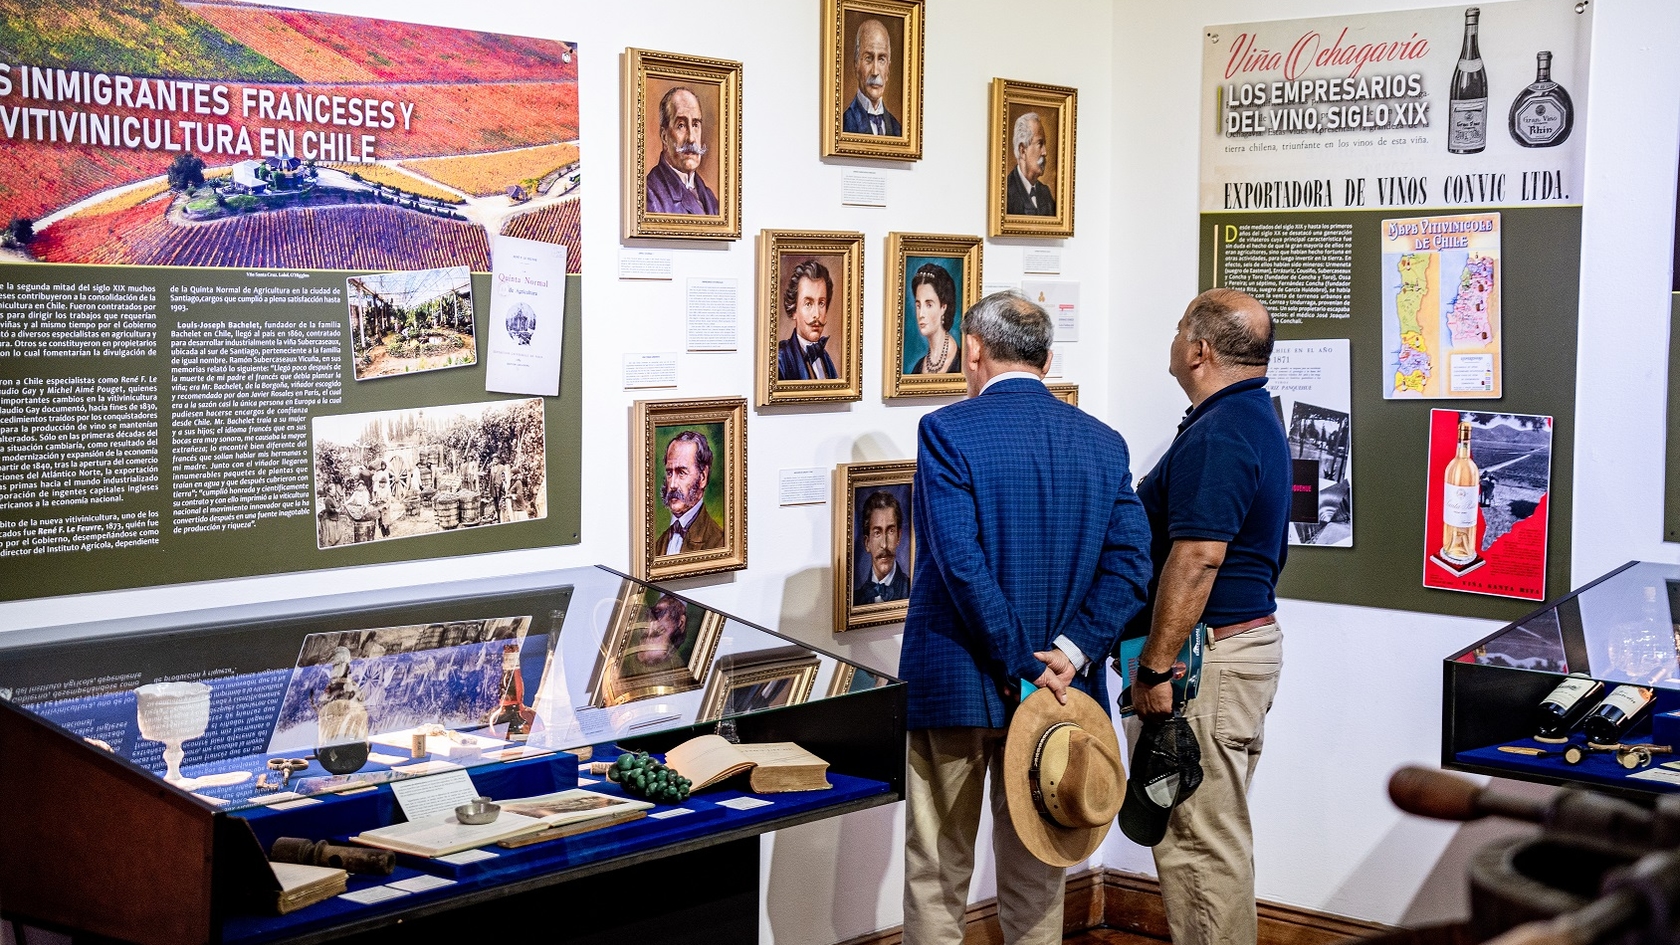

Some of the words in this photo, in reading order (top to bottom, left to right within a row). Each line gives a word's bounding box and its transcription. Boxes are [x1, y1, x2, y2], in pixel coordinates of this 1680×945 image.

[1225, 33, 1282, 80] Viña
[1284, 27, 1430, 82] Ochagavía
[21, 65, 230, 116] INMIGRANTES
[242, 88, 395, 129] FRANCESES
[400, 102, 414, 129] Y
[1229, 83, 1266, 106] LOS
[1271, 74, 1421, 103] EMPRESARIOS
[0, 105, 253, 155] VITIVINICULTURA
[260, 127, 294, 157] EN
[303, 131, 376, 163] CHILE
[1228, 110, 1266, 133] DEL
[1270, 107, 1322, 131] VINO,
[1327, 103, 1389, 128] SIGLO
[1393, 101, 1428, 125] XIX
[1224, 143, 1245, 153] tierra
[1249, 142, 1278, 152] chilena,
[1282, 140, 1321, 150] triunfante
[1338, 139, 1349, 148] los
[1353, 138, 1373, 147] vinos
[1377, 138, 1387, 146] de
[1391, 137, 1407, 146] esta
[1410, 136, 1428, 145] viña.
[1224, 179, 1333, 209] EXPORTADORA
[1345, 178, 1366, 206] DE
[1377, 176, 1427, 205] VINOS
[1444, 173, 1506, 204] CONVIC
[1521, 170, 1569, 201] LTDA.
[1415, 239, 1430, 250] DE
[1433, 235, 1468, 252] CHILE
